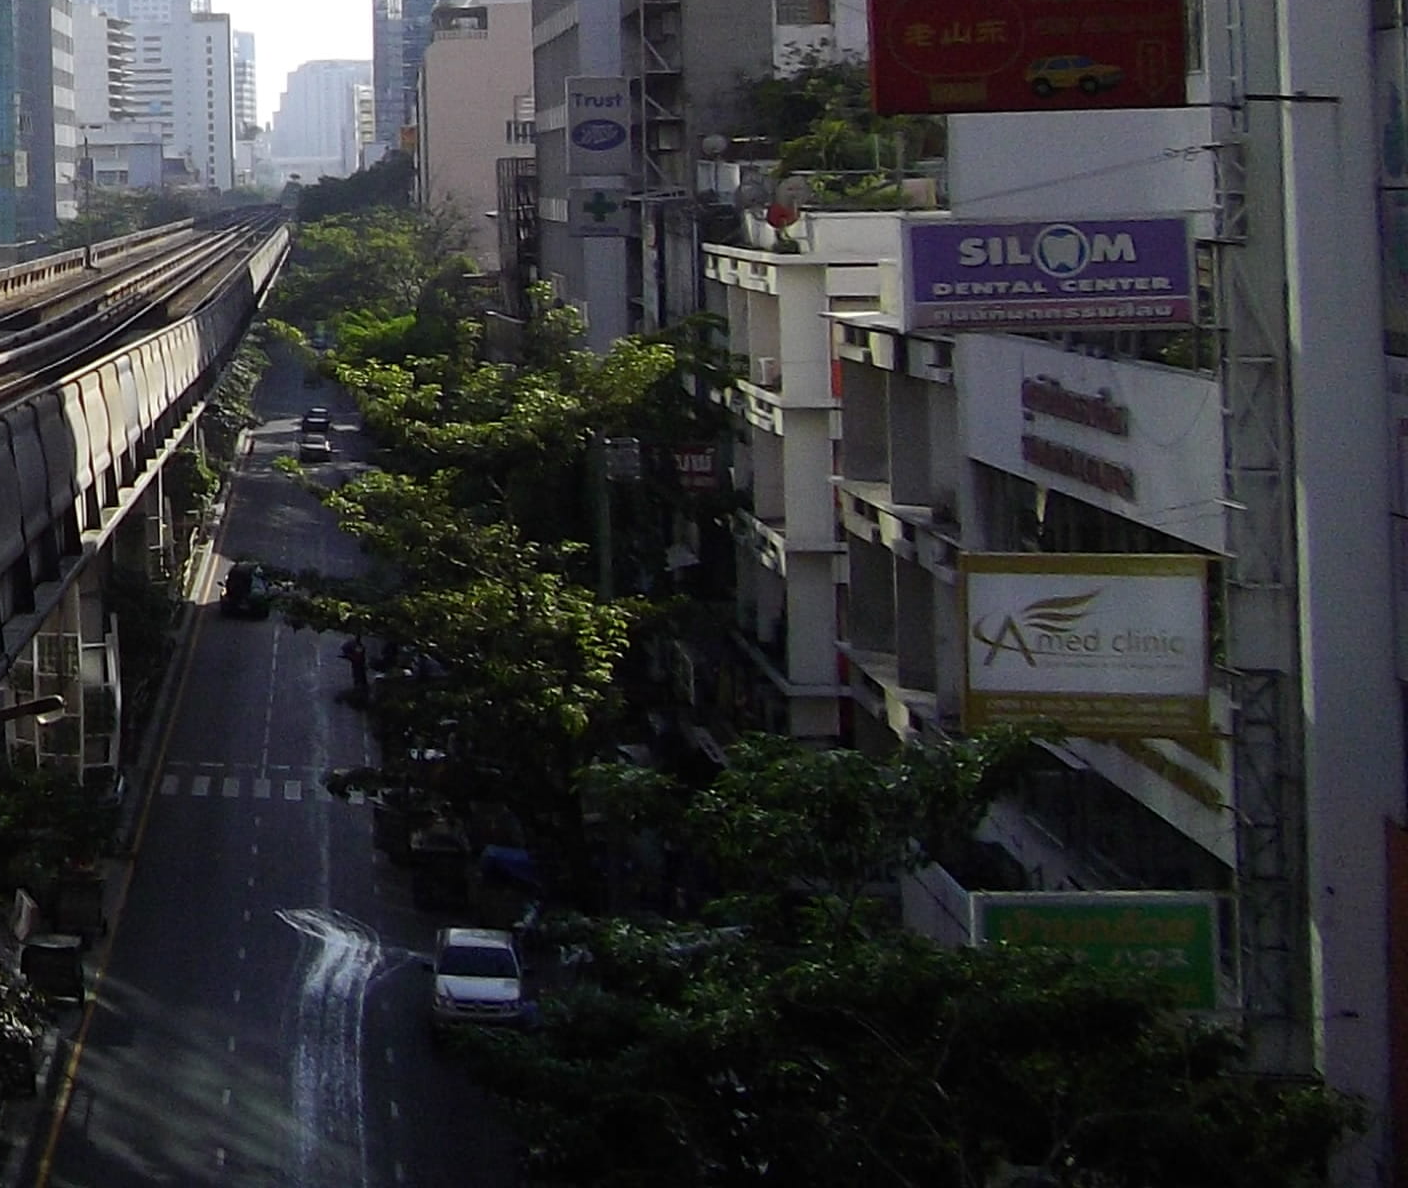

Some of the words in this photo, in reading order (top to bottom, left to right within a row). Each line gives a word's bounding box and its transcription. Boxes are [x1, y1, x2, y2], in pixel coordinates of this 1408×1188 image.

[570, 92, 624, 109] Trust
[959, 223, 1136, 278] SILOM
[934, 280, 1049, 297] DENTAL
[1059, 277, 1173, 293] CENTER
[1110, 628, 1184, 654] clinic
